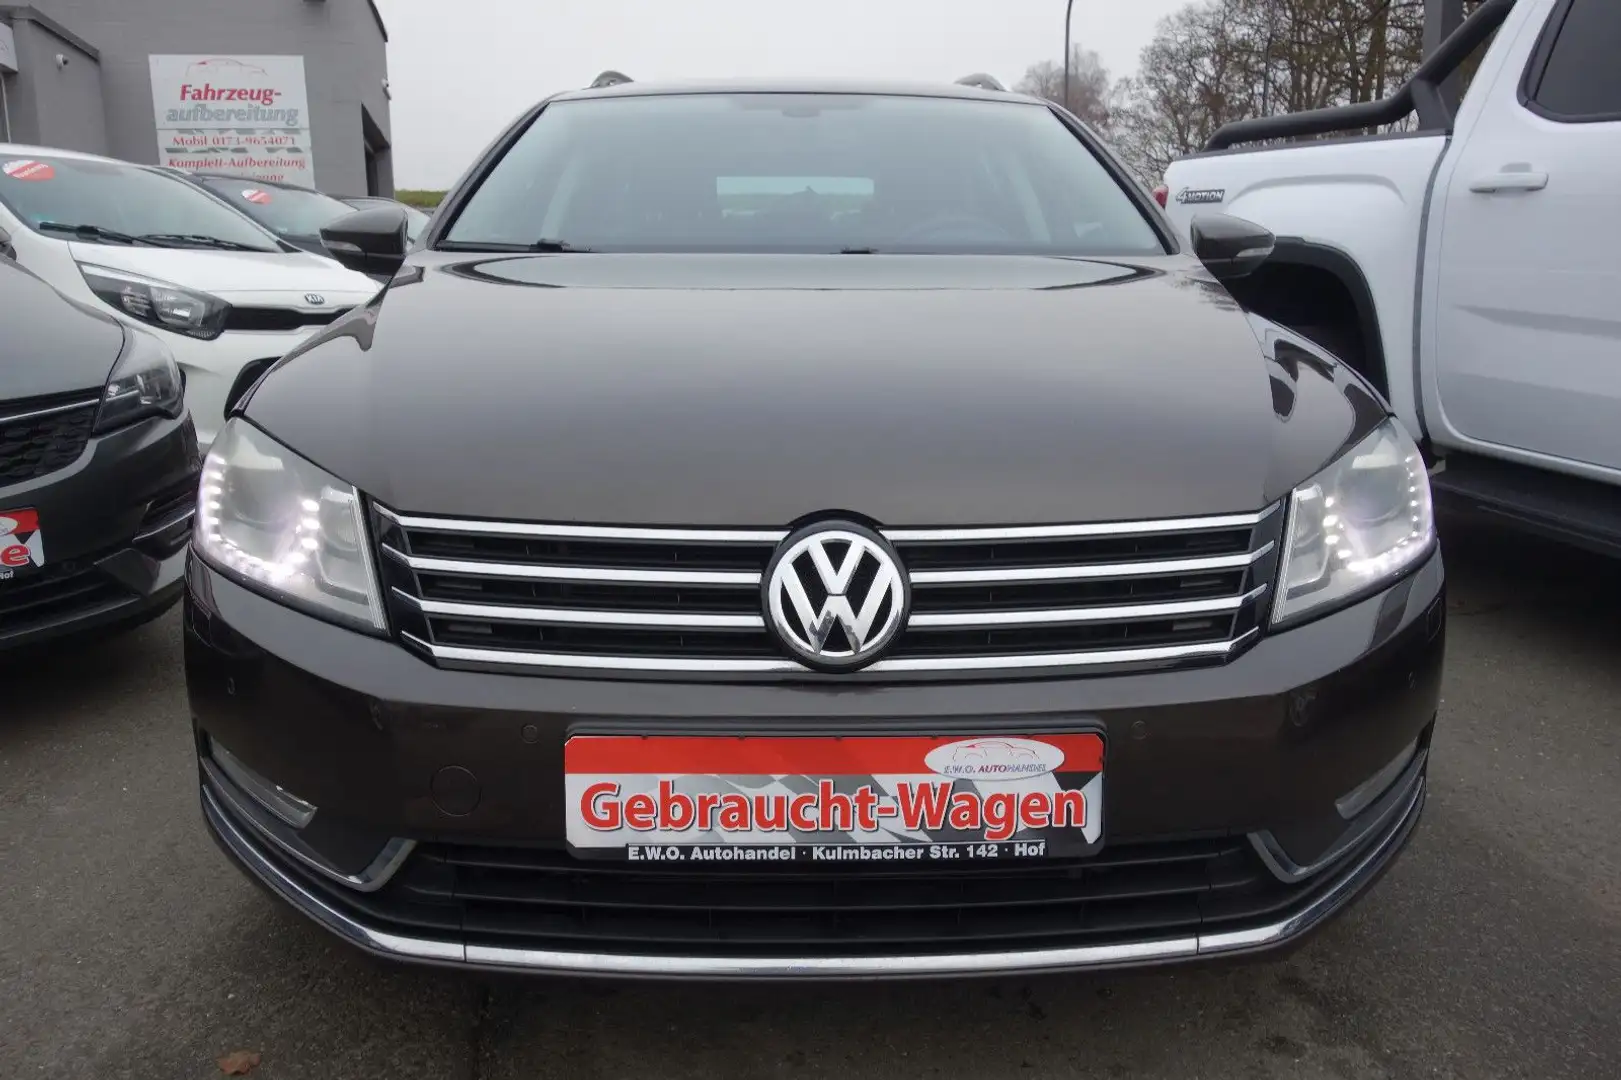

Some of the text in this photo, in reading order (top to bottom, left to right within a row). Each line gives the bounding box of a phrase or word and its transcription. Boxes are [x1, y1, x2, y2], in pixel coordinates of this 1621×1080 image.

[180, 83, 282, 106] Fahrzeug-
[166, 103, 299, 126] aufbereitung
[172, 135, 208, 147] Mobil
[168, 155, 306, 171] Komplett-Aufbereitung
[1175, 187, 1225, 204] 4MOTION
[943, 765, 976, 774] E.W.O.
[580, 779, 1087, 841] Gebraucht-Wagen
[628, 842, 1046, 861] E.W.O. Autohandel Kulmbacher Str. 142 Hof
